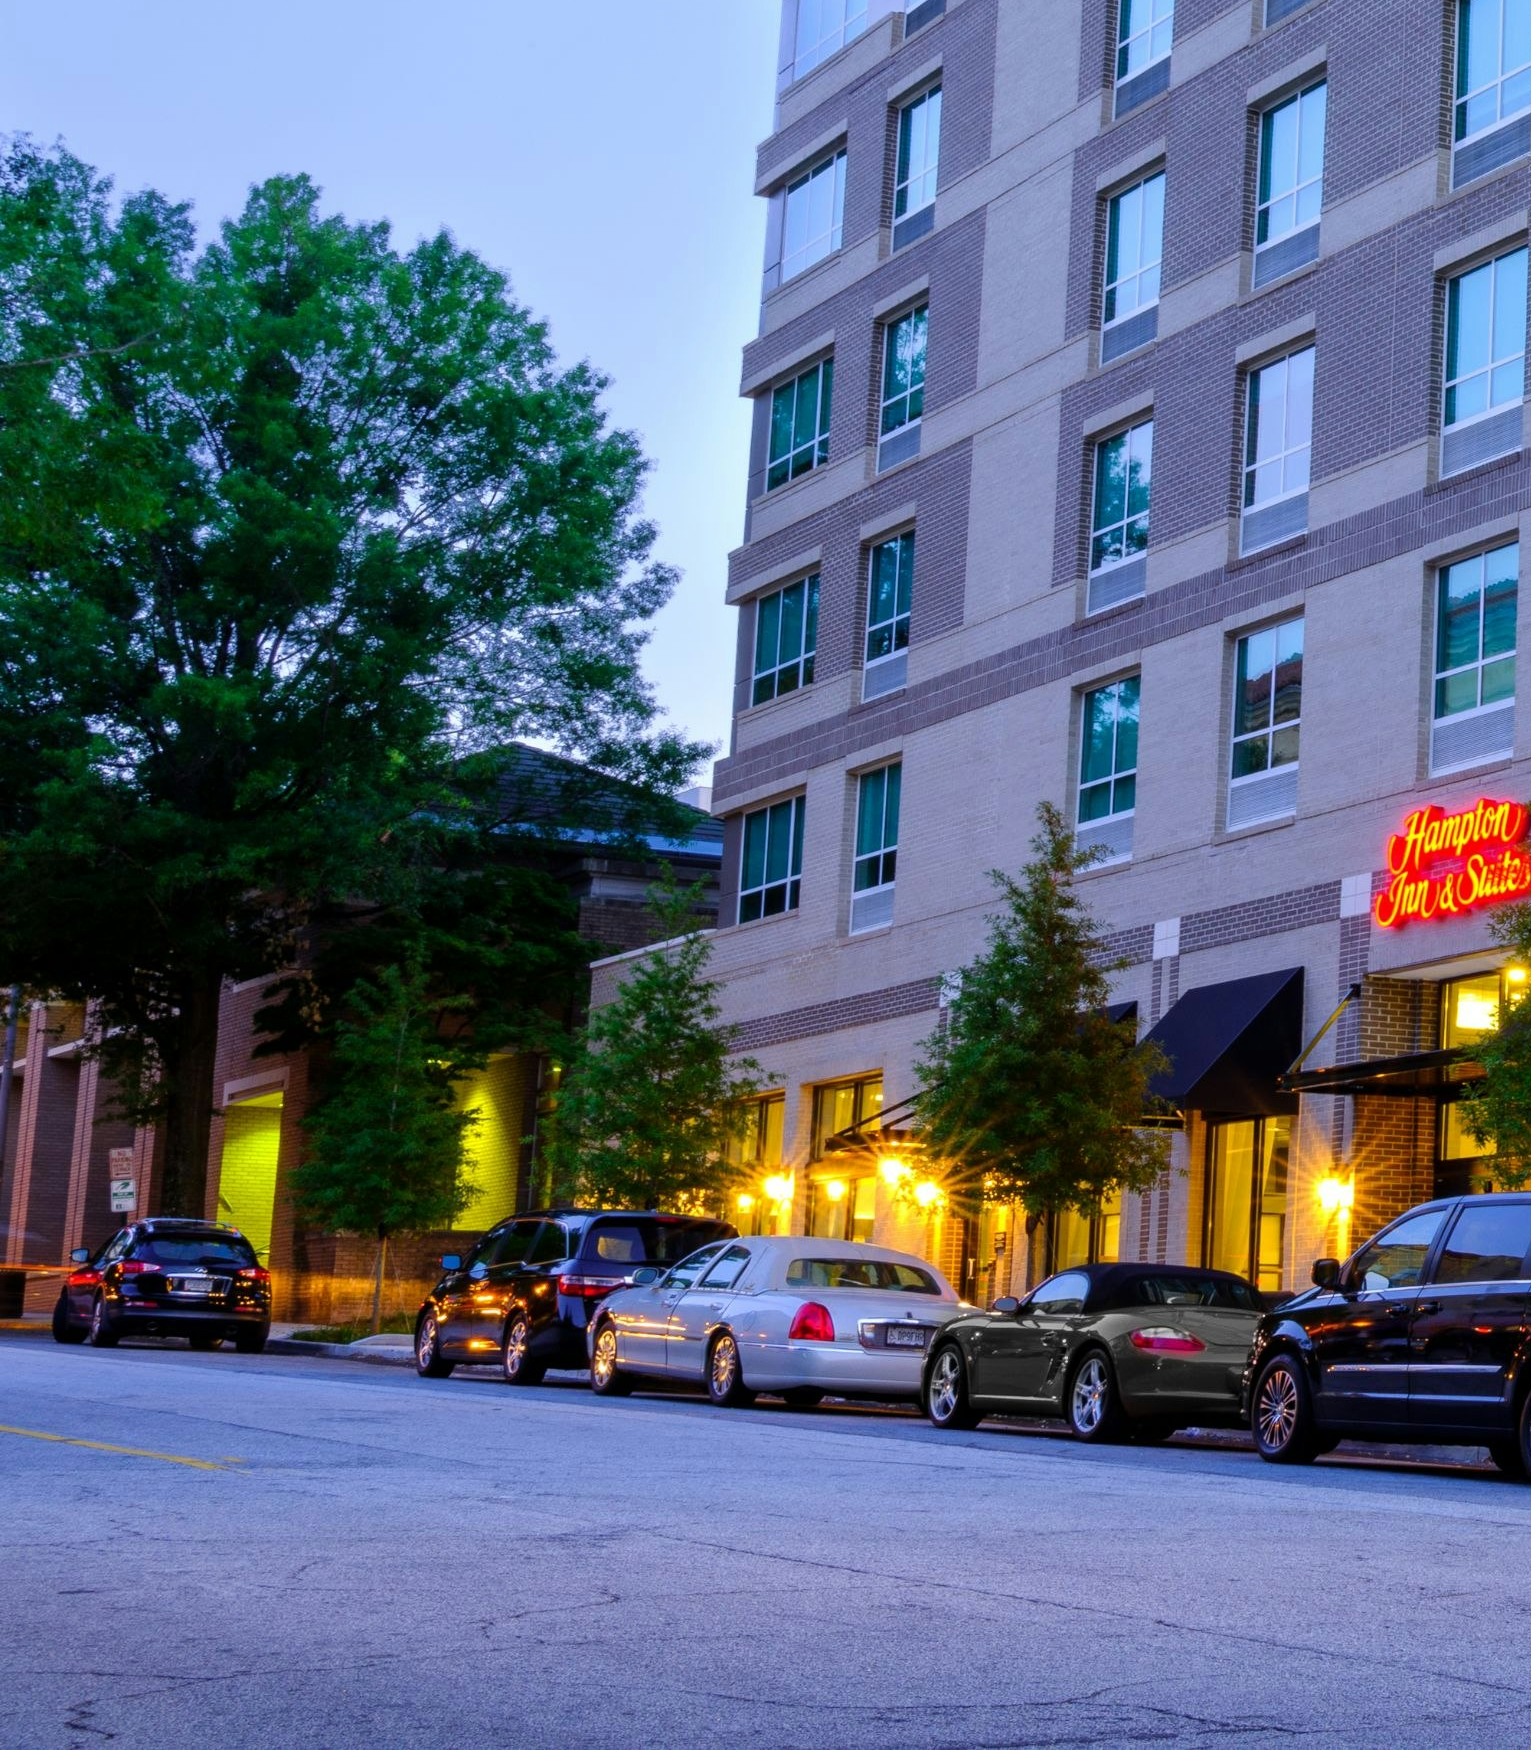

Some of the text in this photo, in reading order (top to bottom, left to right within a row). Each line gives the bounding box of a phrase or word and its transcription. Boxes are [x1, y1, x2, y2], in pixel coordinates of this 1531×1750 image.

[1388, 799, 1522, 875] Hampton
[1375, 872, 1440, 927] Inn
[1439, 873, 1459, 912] &
